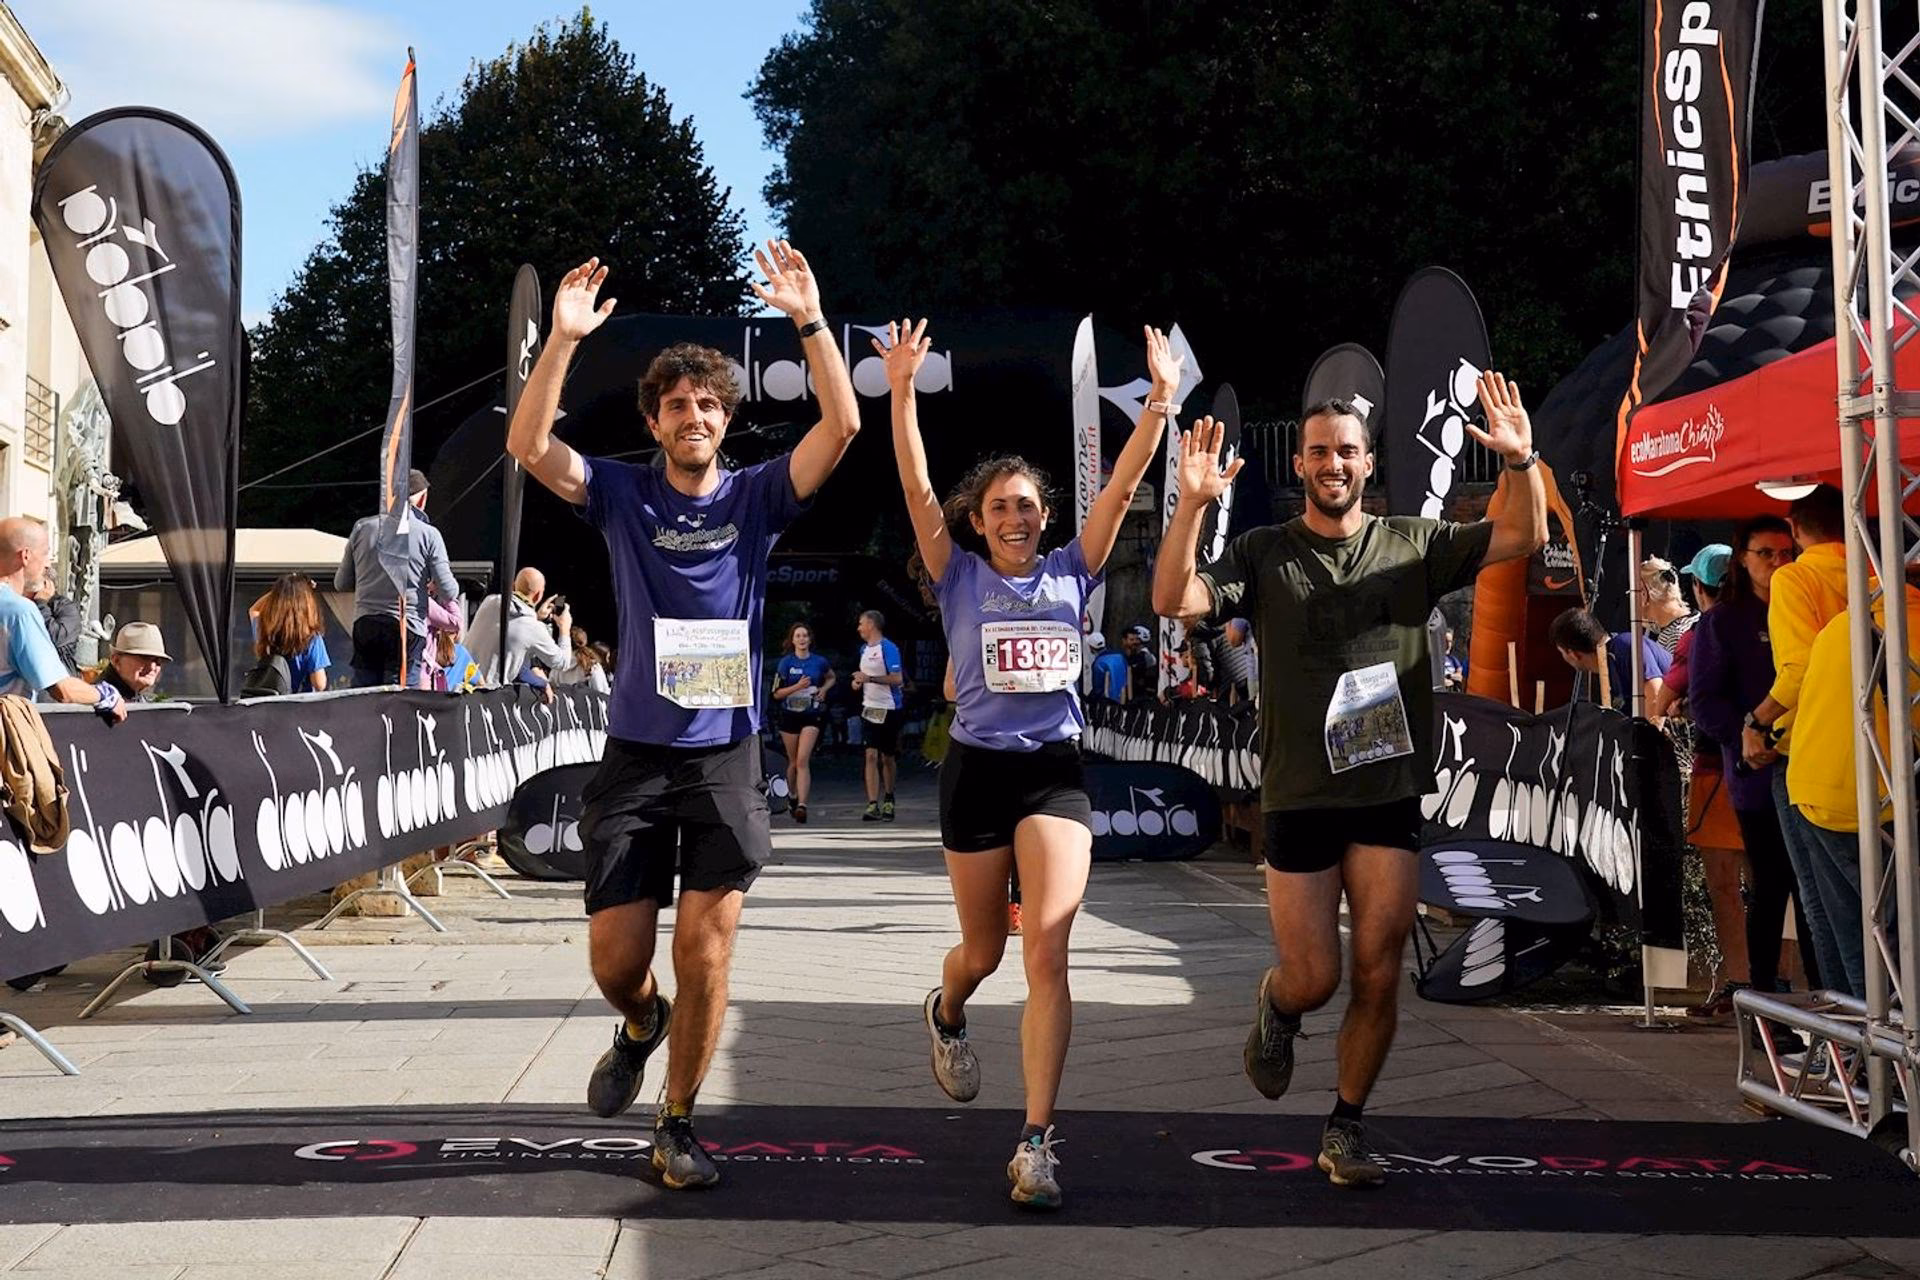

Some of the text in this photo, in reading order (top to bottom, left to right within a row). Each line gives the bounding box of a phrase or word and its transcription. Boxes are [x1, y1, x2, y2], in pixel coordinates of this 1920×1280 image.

[57, 184, 217, 426] diadora
[766, 565, 839, 586] cSport
[999, 638, 1067, 669] 1382
[257, 727, 367, 872] diadora
[378, 710, 458, 839] diadora
[1091, 786, 1200, 837] adora
[67, 740, 244, 915] diadora
[438, 1151, 650, 1159] TIMING&DA
